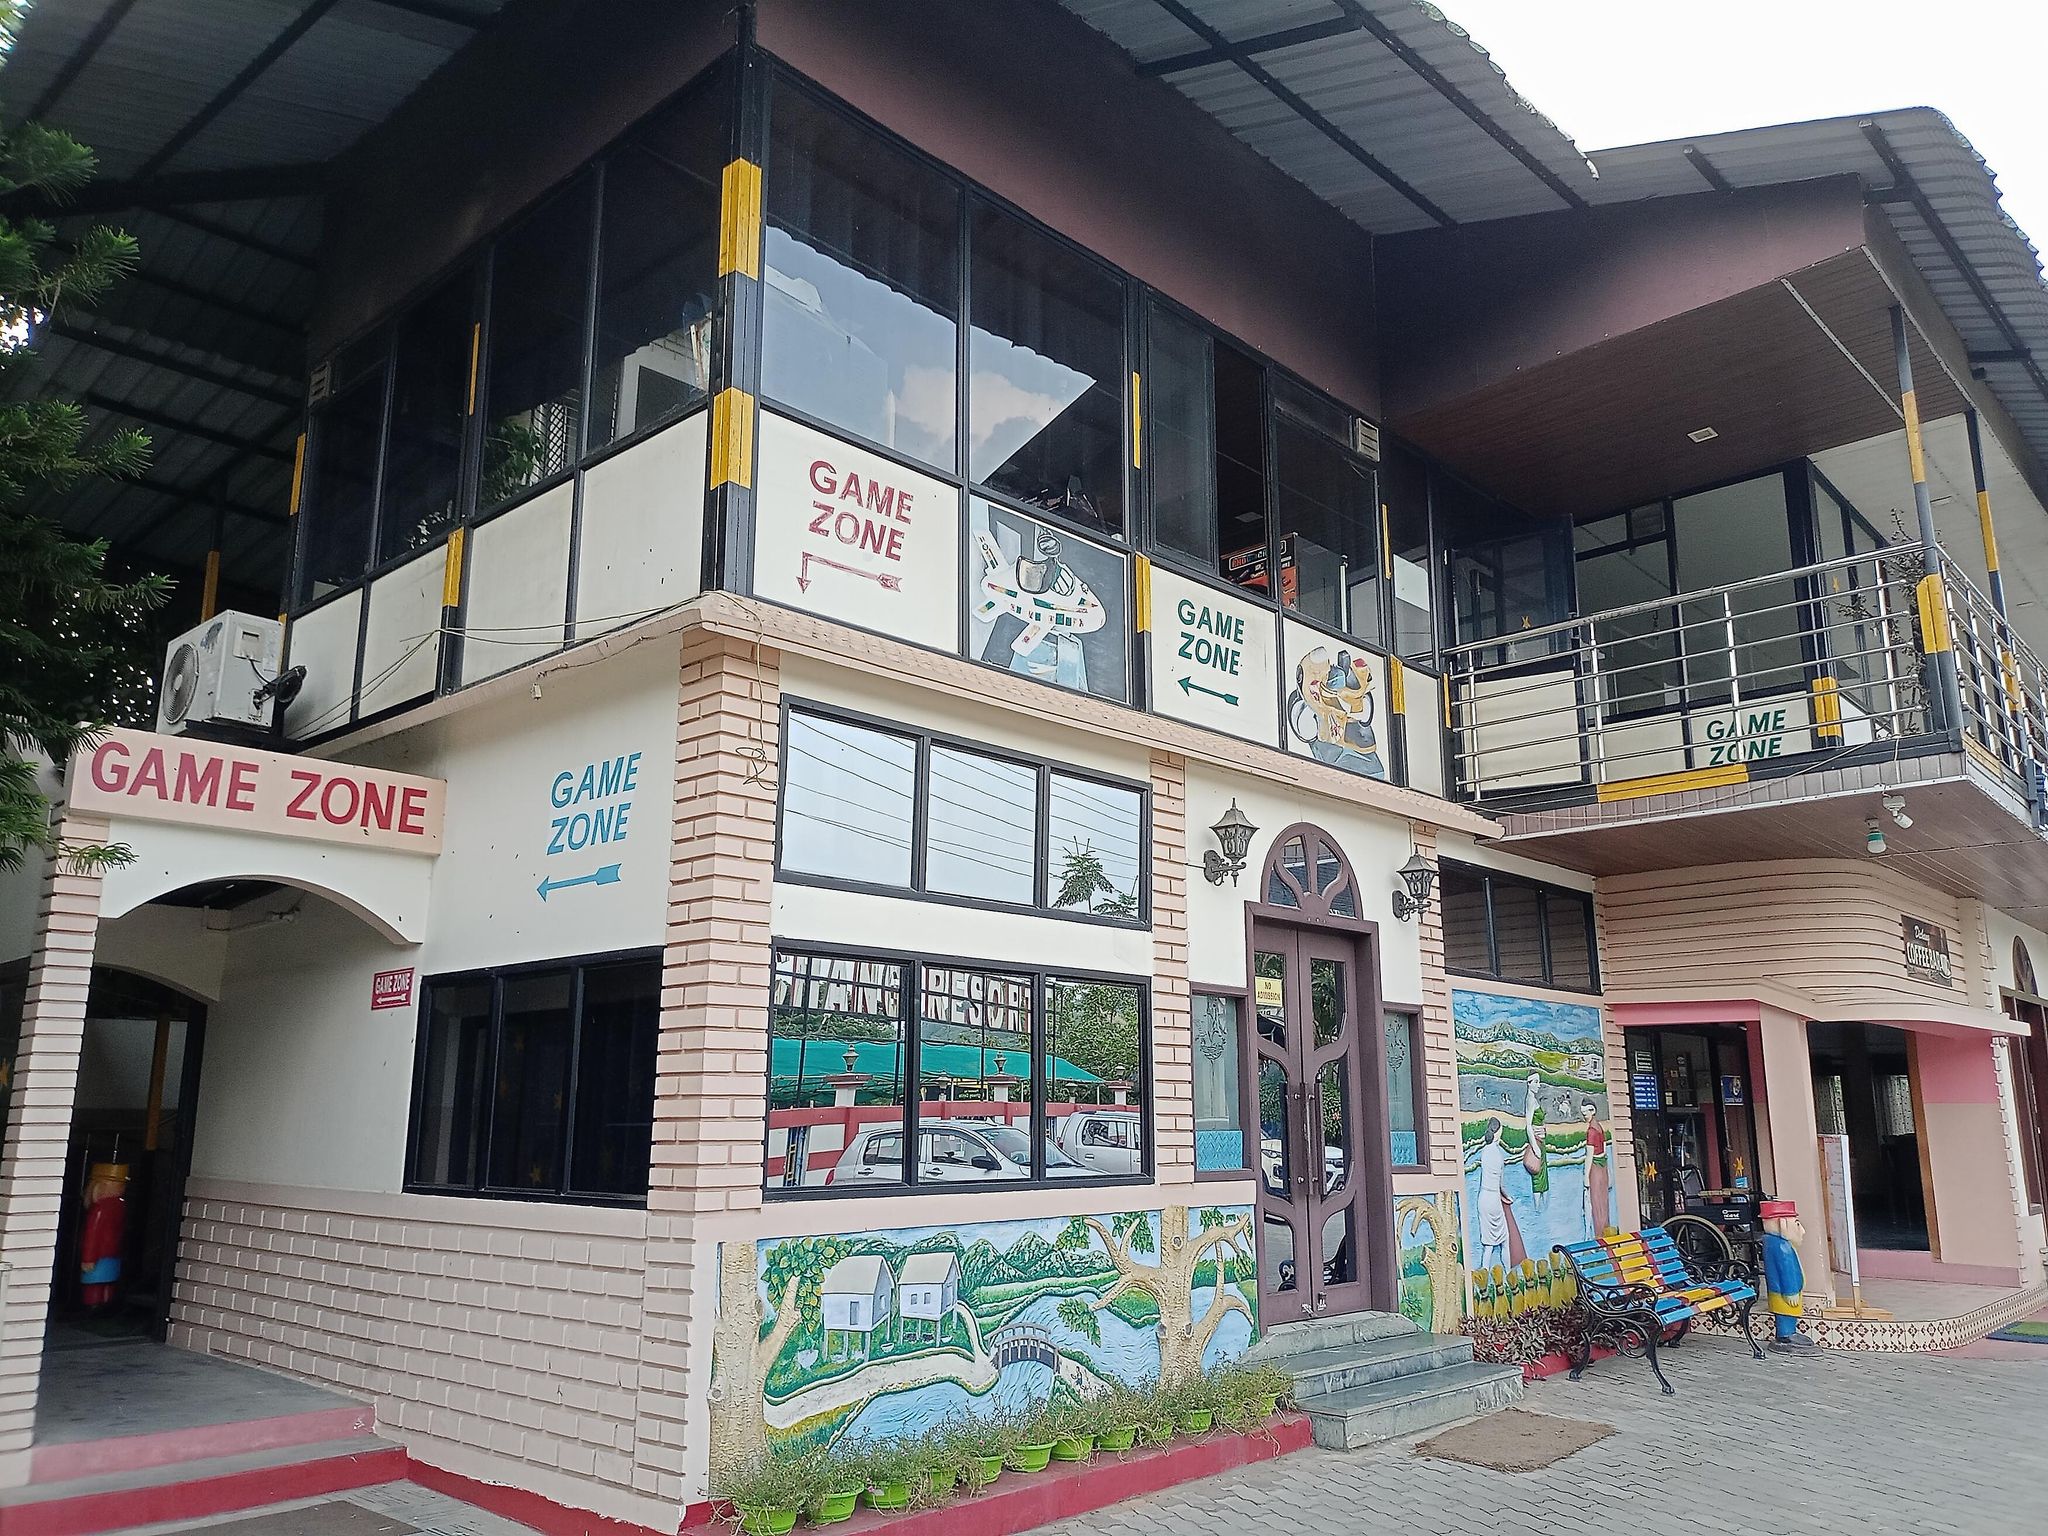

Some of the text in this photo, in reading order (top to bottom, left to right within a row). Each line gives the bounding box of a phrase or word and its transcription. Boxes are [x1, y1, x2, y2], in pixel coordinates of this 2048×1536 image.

[809, 460, 913, 524] GAME
[809, 500, 904, 561] ZONE
[1178, 599, 1244, 644] GAME
[1178, 631, 1240, 676] ZONE
[1707, 709, 1786, 740] GAME
[1710, 737, 1782, 766] ZONE
[91, 741, 428, 835] GAME ZONE
[550, 752, 642, 809] GAME
[547, 802, 632, 855] ZONE
[375, 972, 411, 995] GAME ZONE
[1264, 981, 1272, 990] NO
